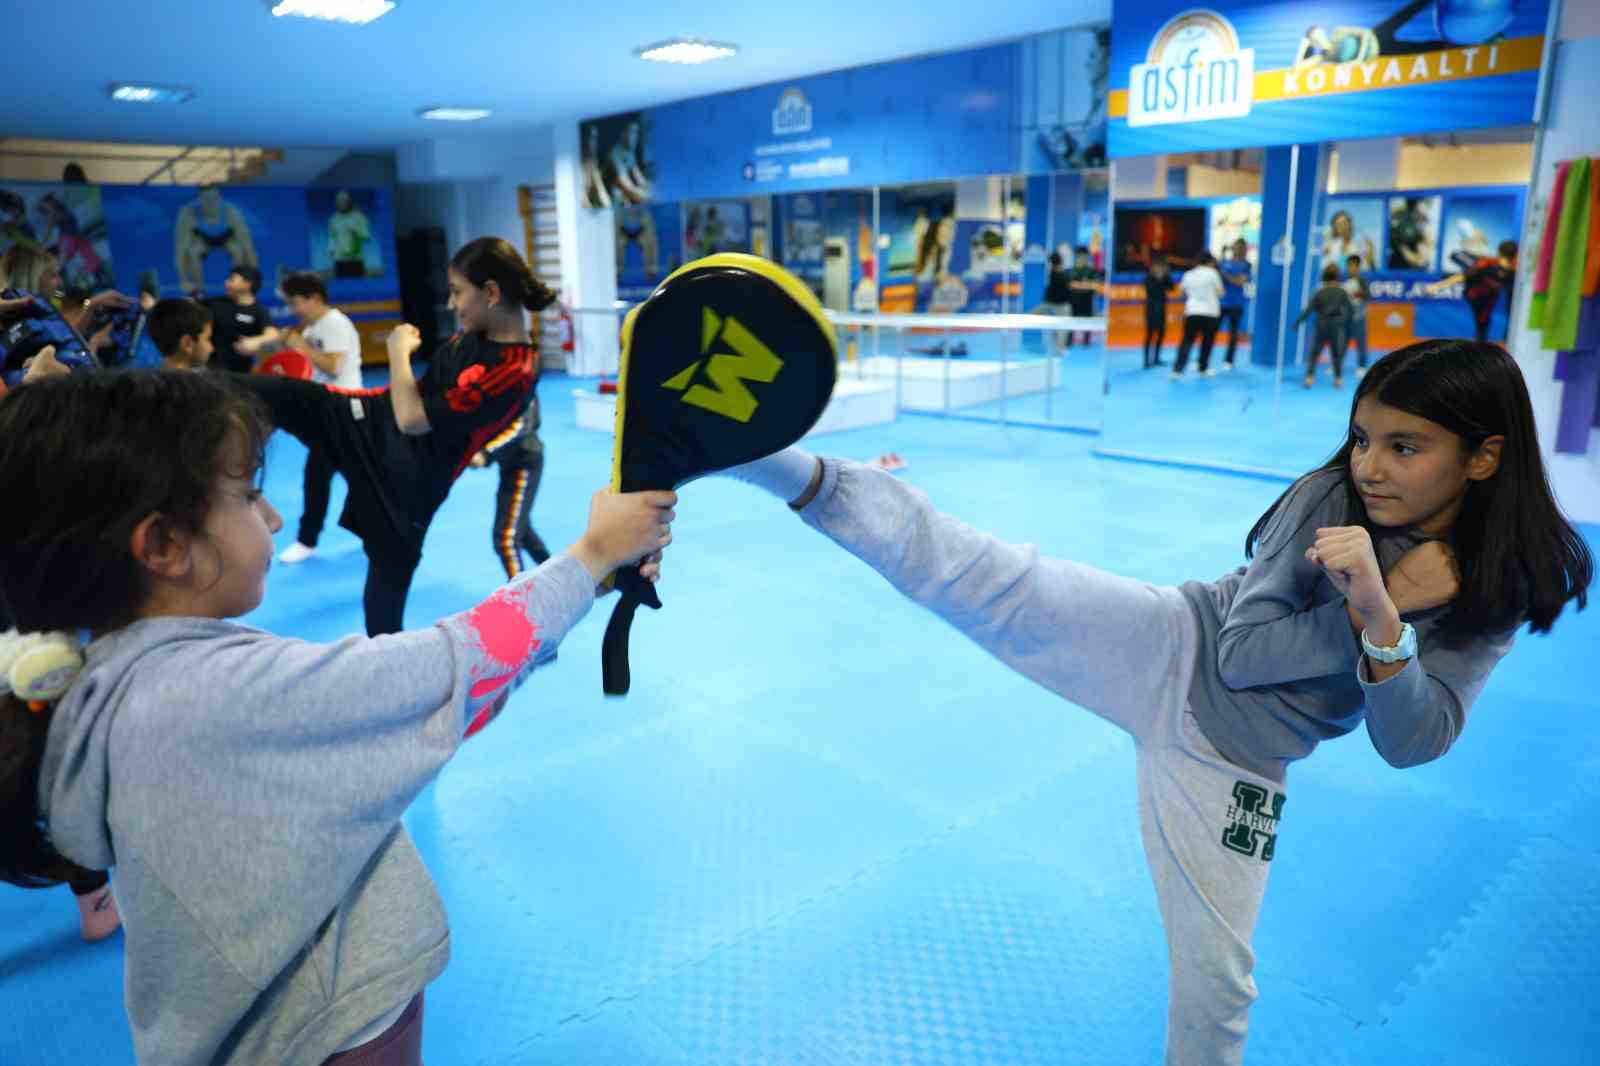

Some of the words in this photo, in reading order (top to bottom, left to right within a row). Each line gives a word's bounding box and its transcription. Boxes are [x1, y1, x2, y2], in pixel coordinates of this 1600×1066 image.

[1143, 48, 1239, 113] asfim
[1284, 48, 1498, 94] KONYAALTI
[1226, 804, 1278, 832] HARVA
